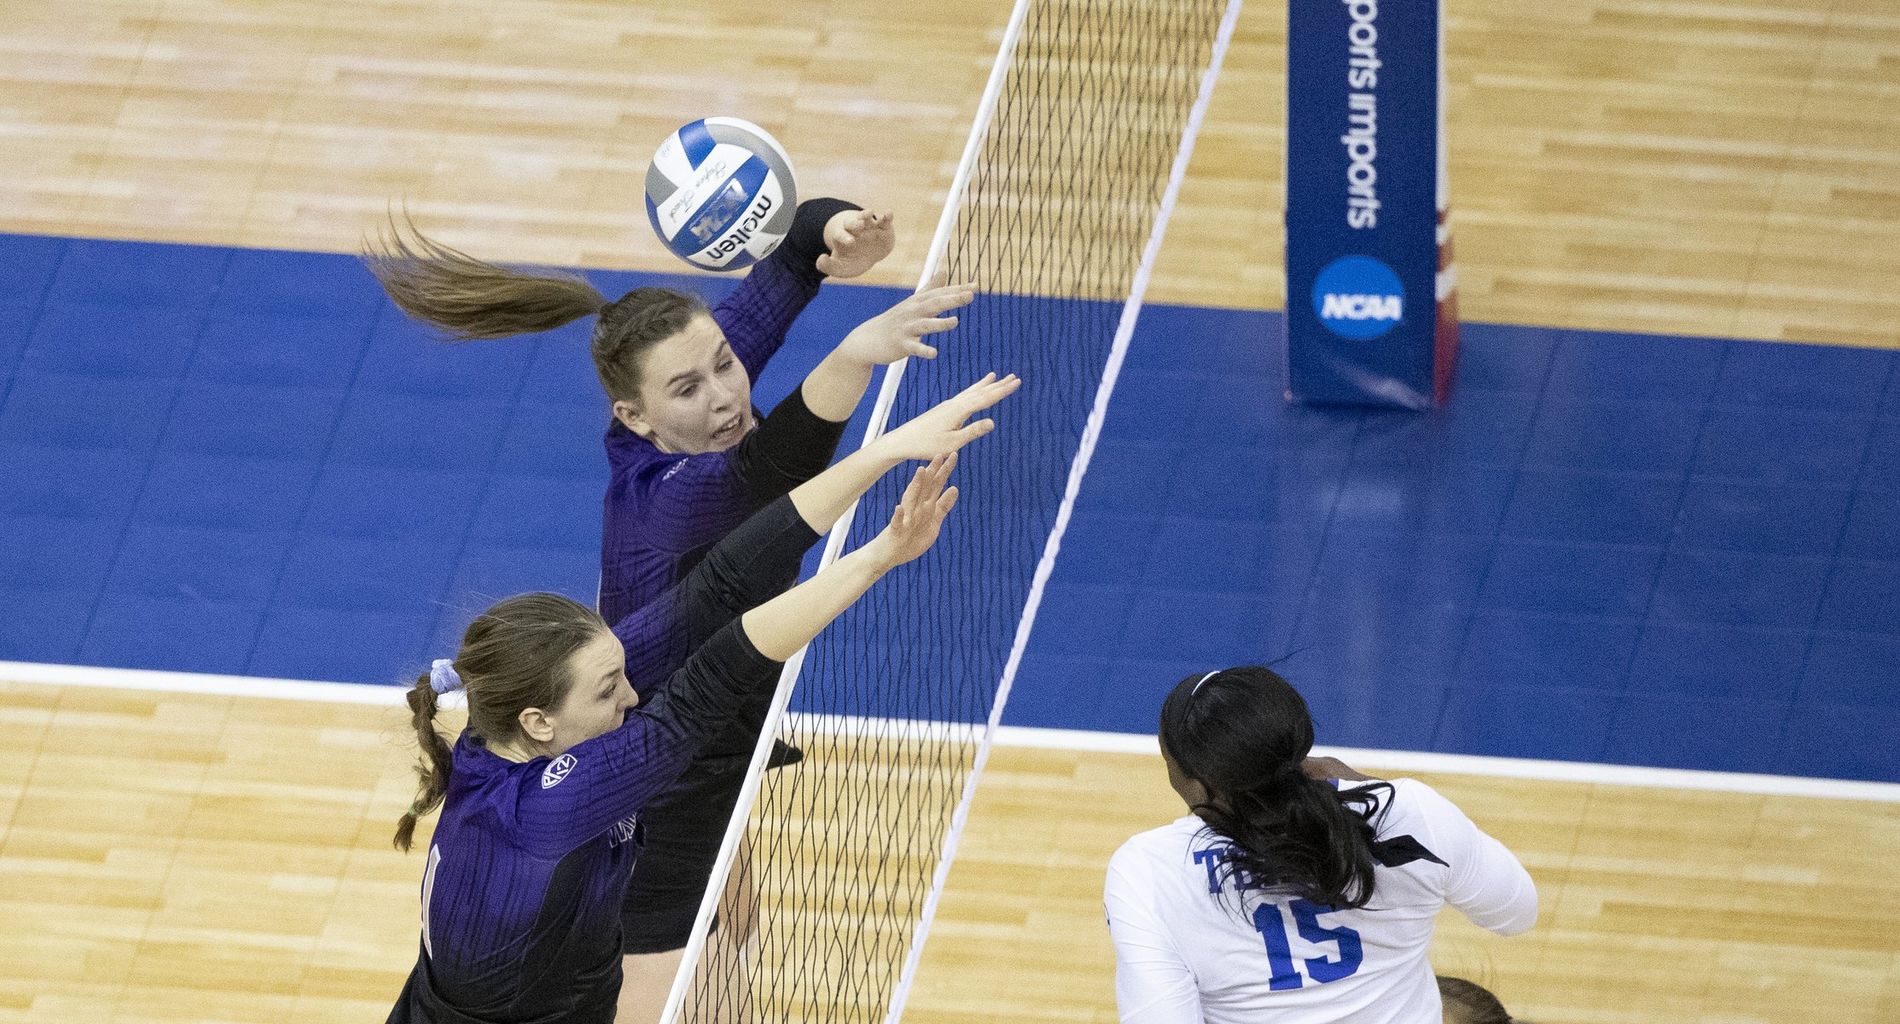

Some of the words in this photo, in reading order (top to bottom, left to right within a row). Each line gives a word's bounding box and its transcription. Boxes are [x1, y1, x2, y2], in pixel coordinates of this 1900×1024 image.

[1342, 0, 1382, 89] ports
[1340, 92, 1381, 229] imports
[706, 194, 772, 260] molten
[1321, 293, 1402, 320] NCAA
[1252, 899, 1364, 991] 15
